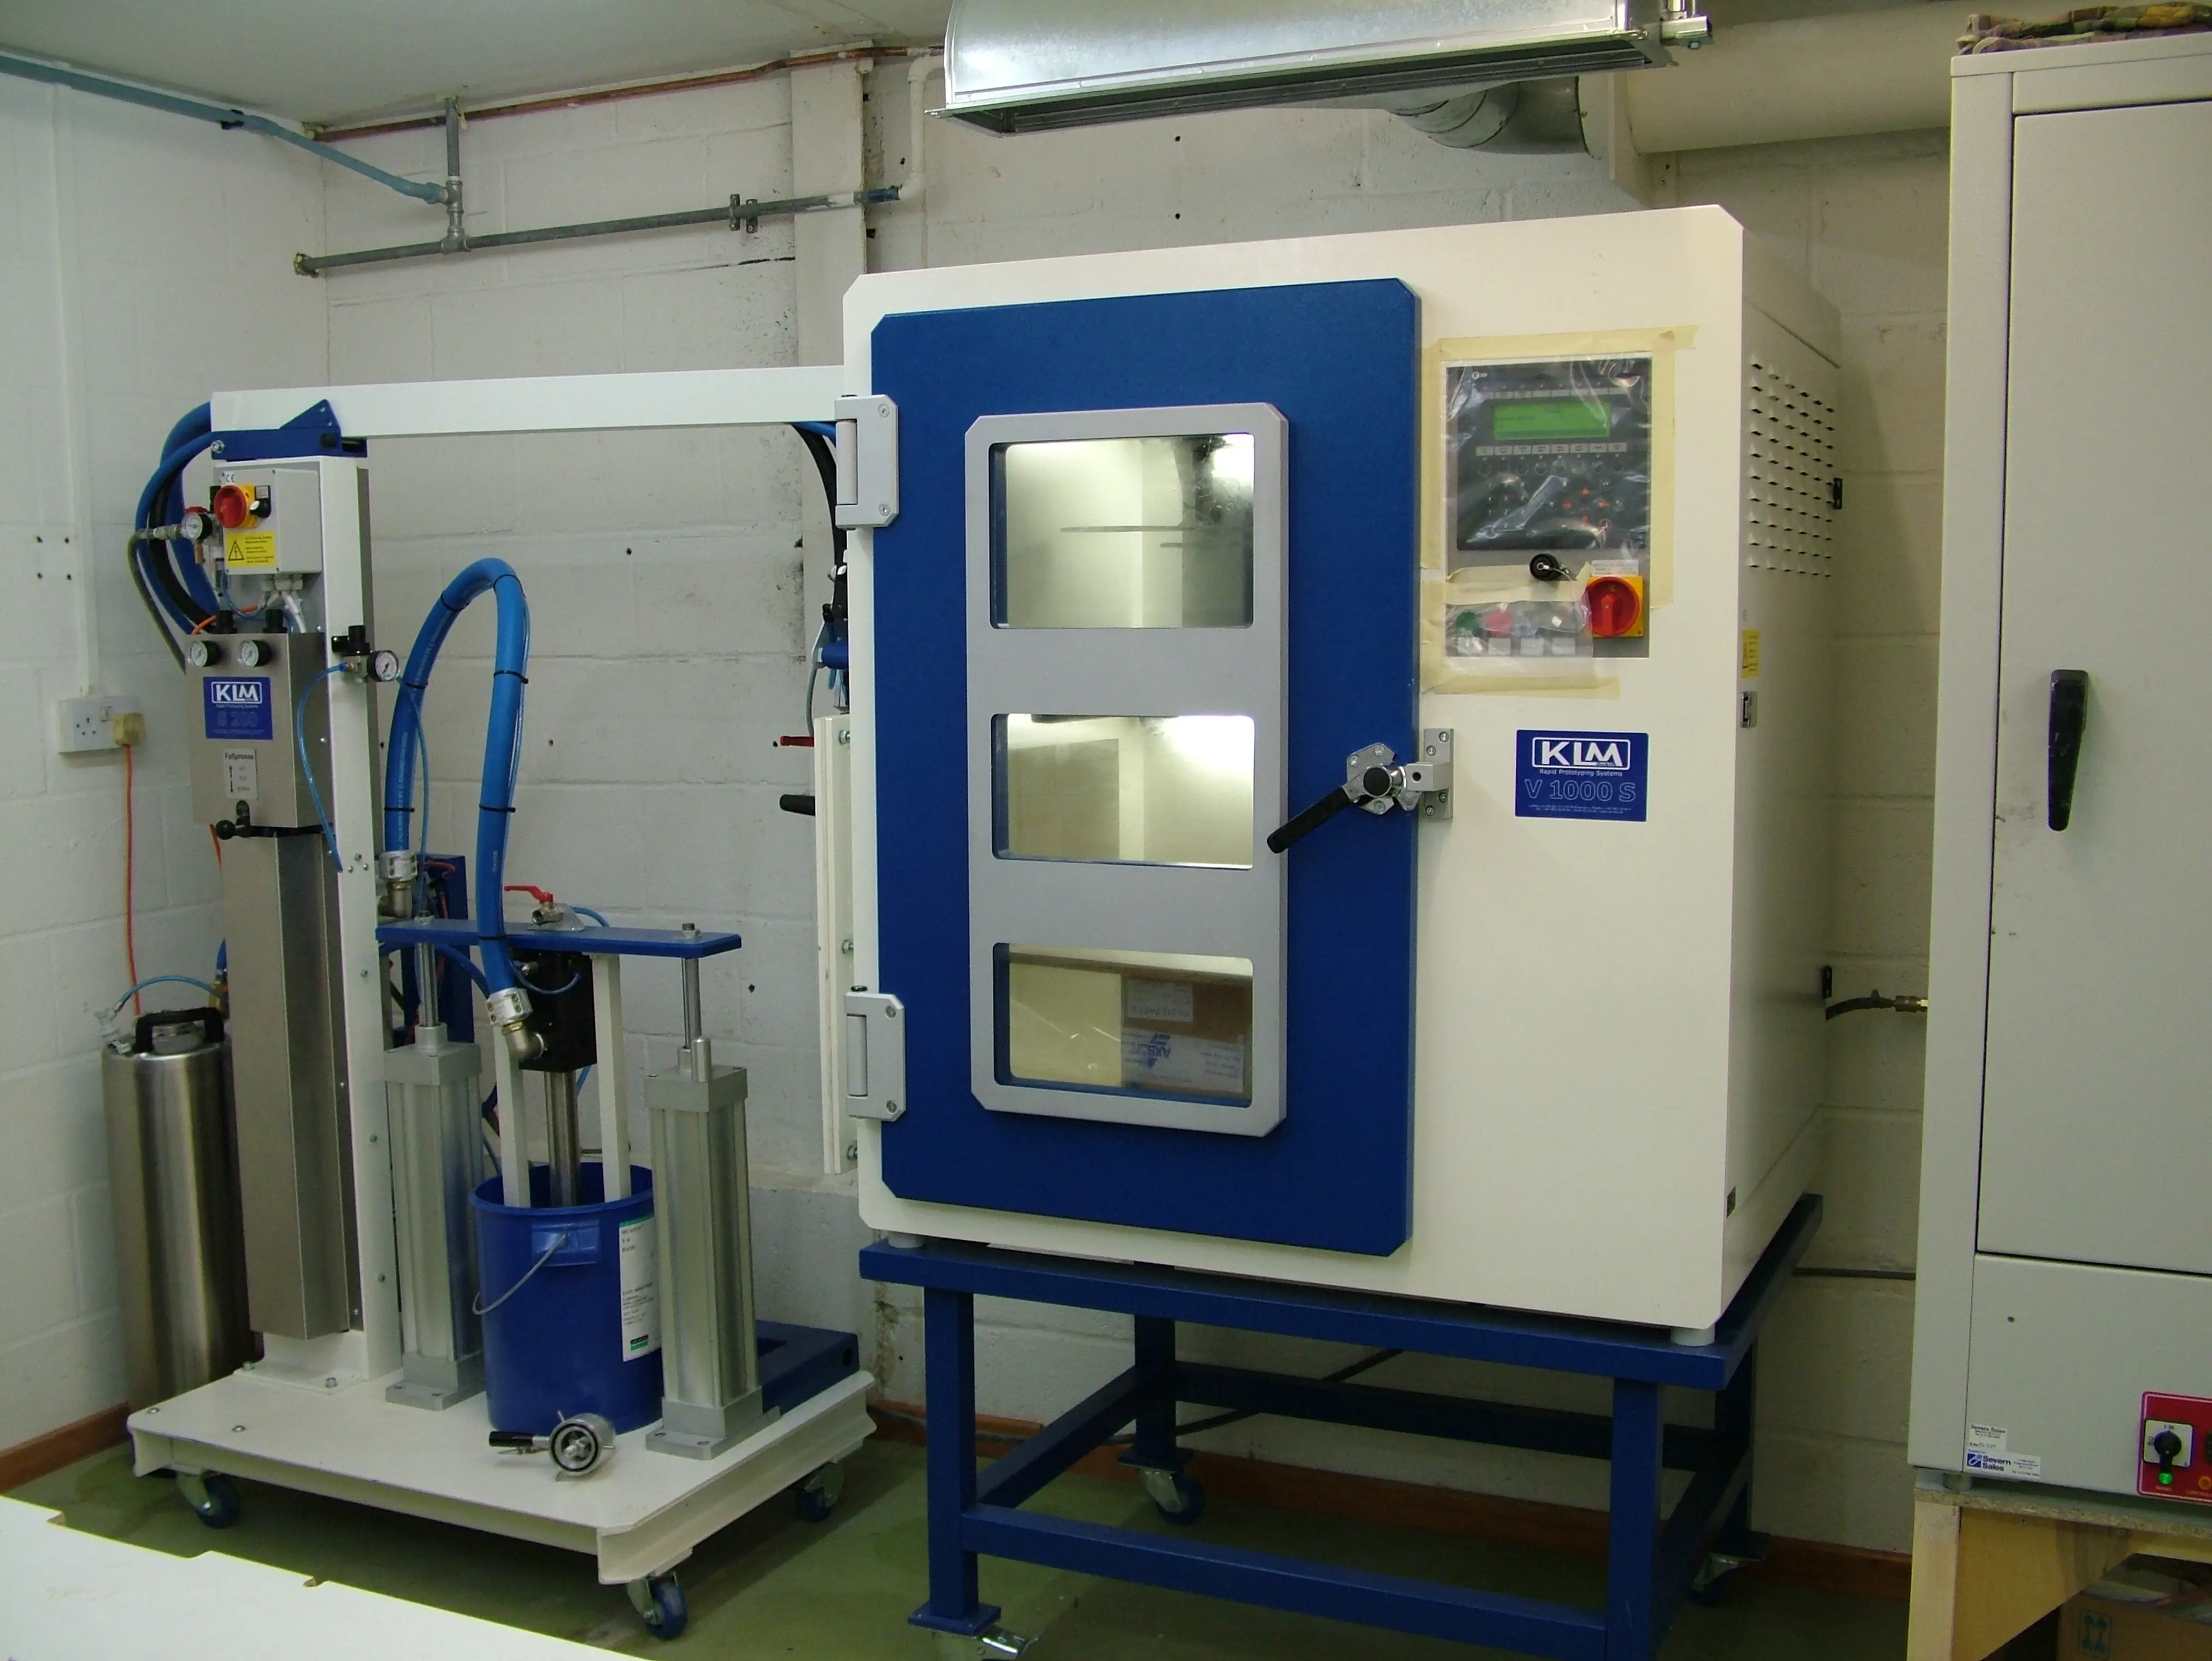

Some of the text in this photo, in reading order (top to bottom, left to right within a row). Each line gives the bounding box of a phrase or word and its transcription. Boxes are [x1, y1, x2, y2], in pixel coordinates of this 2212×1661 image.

[216, 684, 258, 702] KLM
[1542, 740, 1623, 767] KLM
[1558, 769, 1595, 777] Prototyping
[1524, 779, 1636, 803] V 1000 S
[1982, 1455, 2011, 1465] Severn
[1982, 1462, 2004, 1471] Sales
